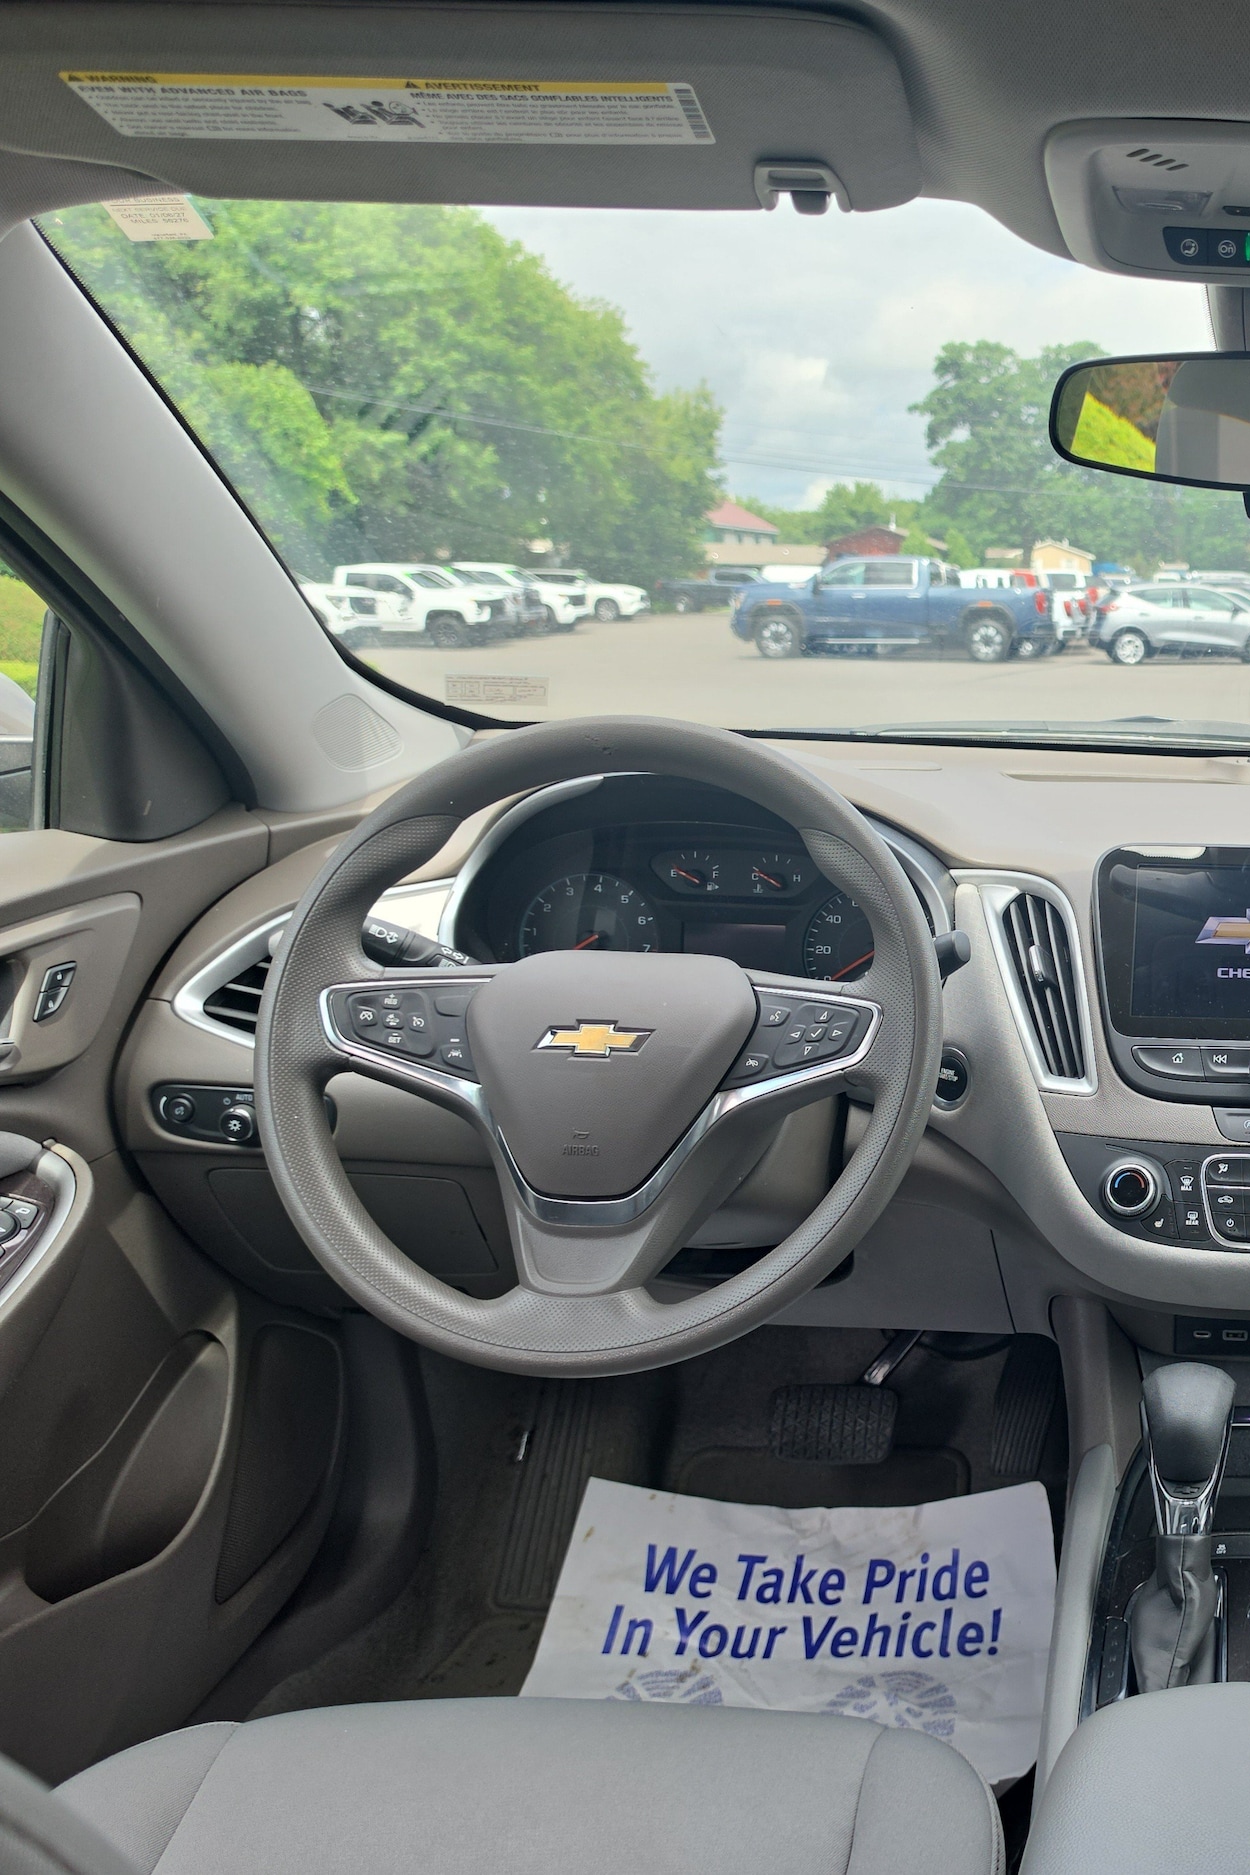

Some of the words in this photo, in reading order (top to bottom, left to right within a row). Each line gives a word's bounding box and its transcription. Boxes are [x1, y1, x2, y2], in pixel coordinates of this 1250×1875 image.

[85, 75, 157, 83] WARNING
[77, 85, 115, 93] EVEN
[118, 86, 154, 94] WITH
[160, 87, 235, 96] ADVANCED
[240, 89, 266, 97] AIR
[269, 90, 307, 98] BAGS
[424, 82, 541, 92] AVERTISSEMENT
[446, 93, 474, 101] AVEC
[499, 94, 529, 102] SACS
[600, 95, 673, 103] INTELLIGENTS
[670, 869, 678, 878] E
[712, 871, 719, 880] F
[793, 875, 801, 883] H
[566, 887, 574, 896] 3
[593, 884, 603, 893] 4
[621, 894, 630, 904] 5
[543, 903, 552, 913] 2
[638, 916, 647, 926] 6
[825, 914, 842, 924] 40
[815, 945, 832, 955] 20
[384, 997, 398, 1006] RES
[388, 1036, 401, 1044] SET
[562, 1144, 599, 1156] AIRBAG
[643, 1543, 718, 1600] We
[737, 1553, 846, 1606] Take
[862, 1548, 991, 1604] Pride
[601, 1604, 655, 1658] In
[675, 1607, 788, 1660] Your
[801, 1607, 1003, 1660] Vehicle!
